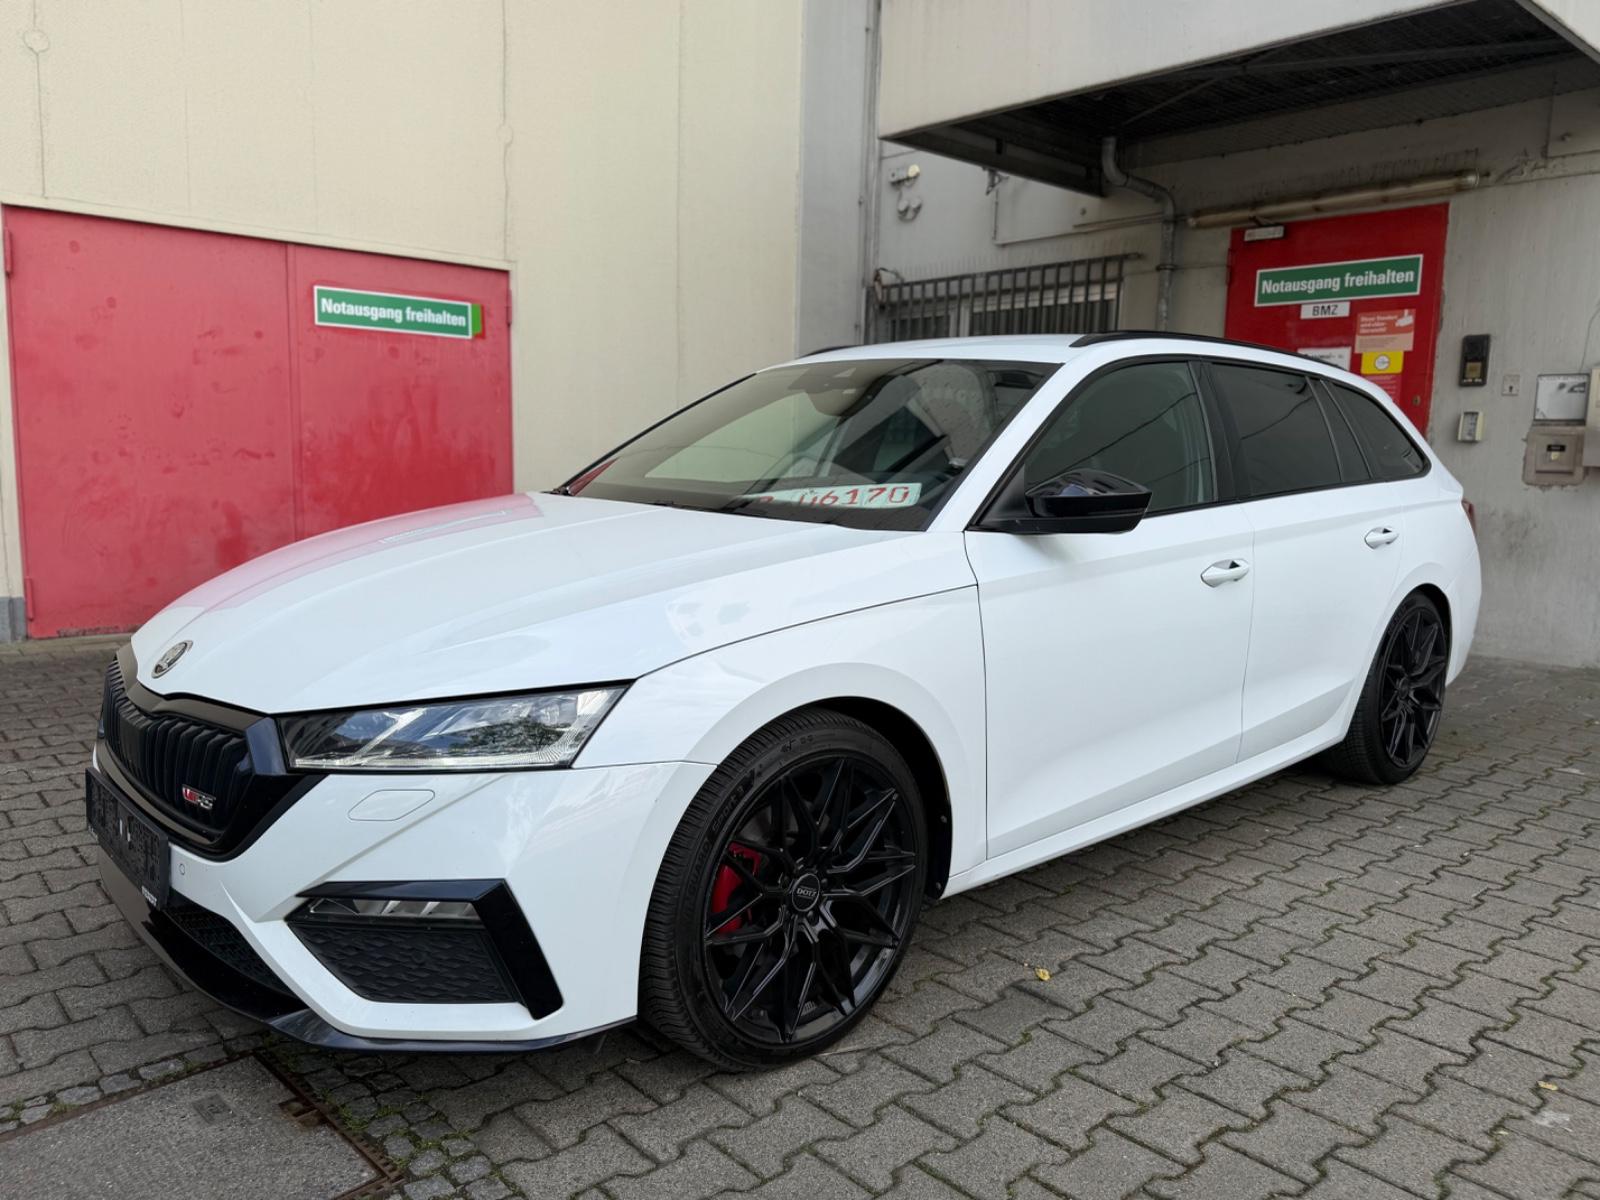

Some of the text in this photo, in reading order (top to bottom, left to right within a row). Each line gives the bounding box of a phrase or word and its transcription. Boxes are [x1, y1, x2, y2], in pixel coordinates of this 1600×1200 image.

[1261, 269, 1414, 294] Notausgang freihalten
[320, 297, 466, 327] Notausgang freihalten
[1312, 304, 1339, 317] BMZ
